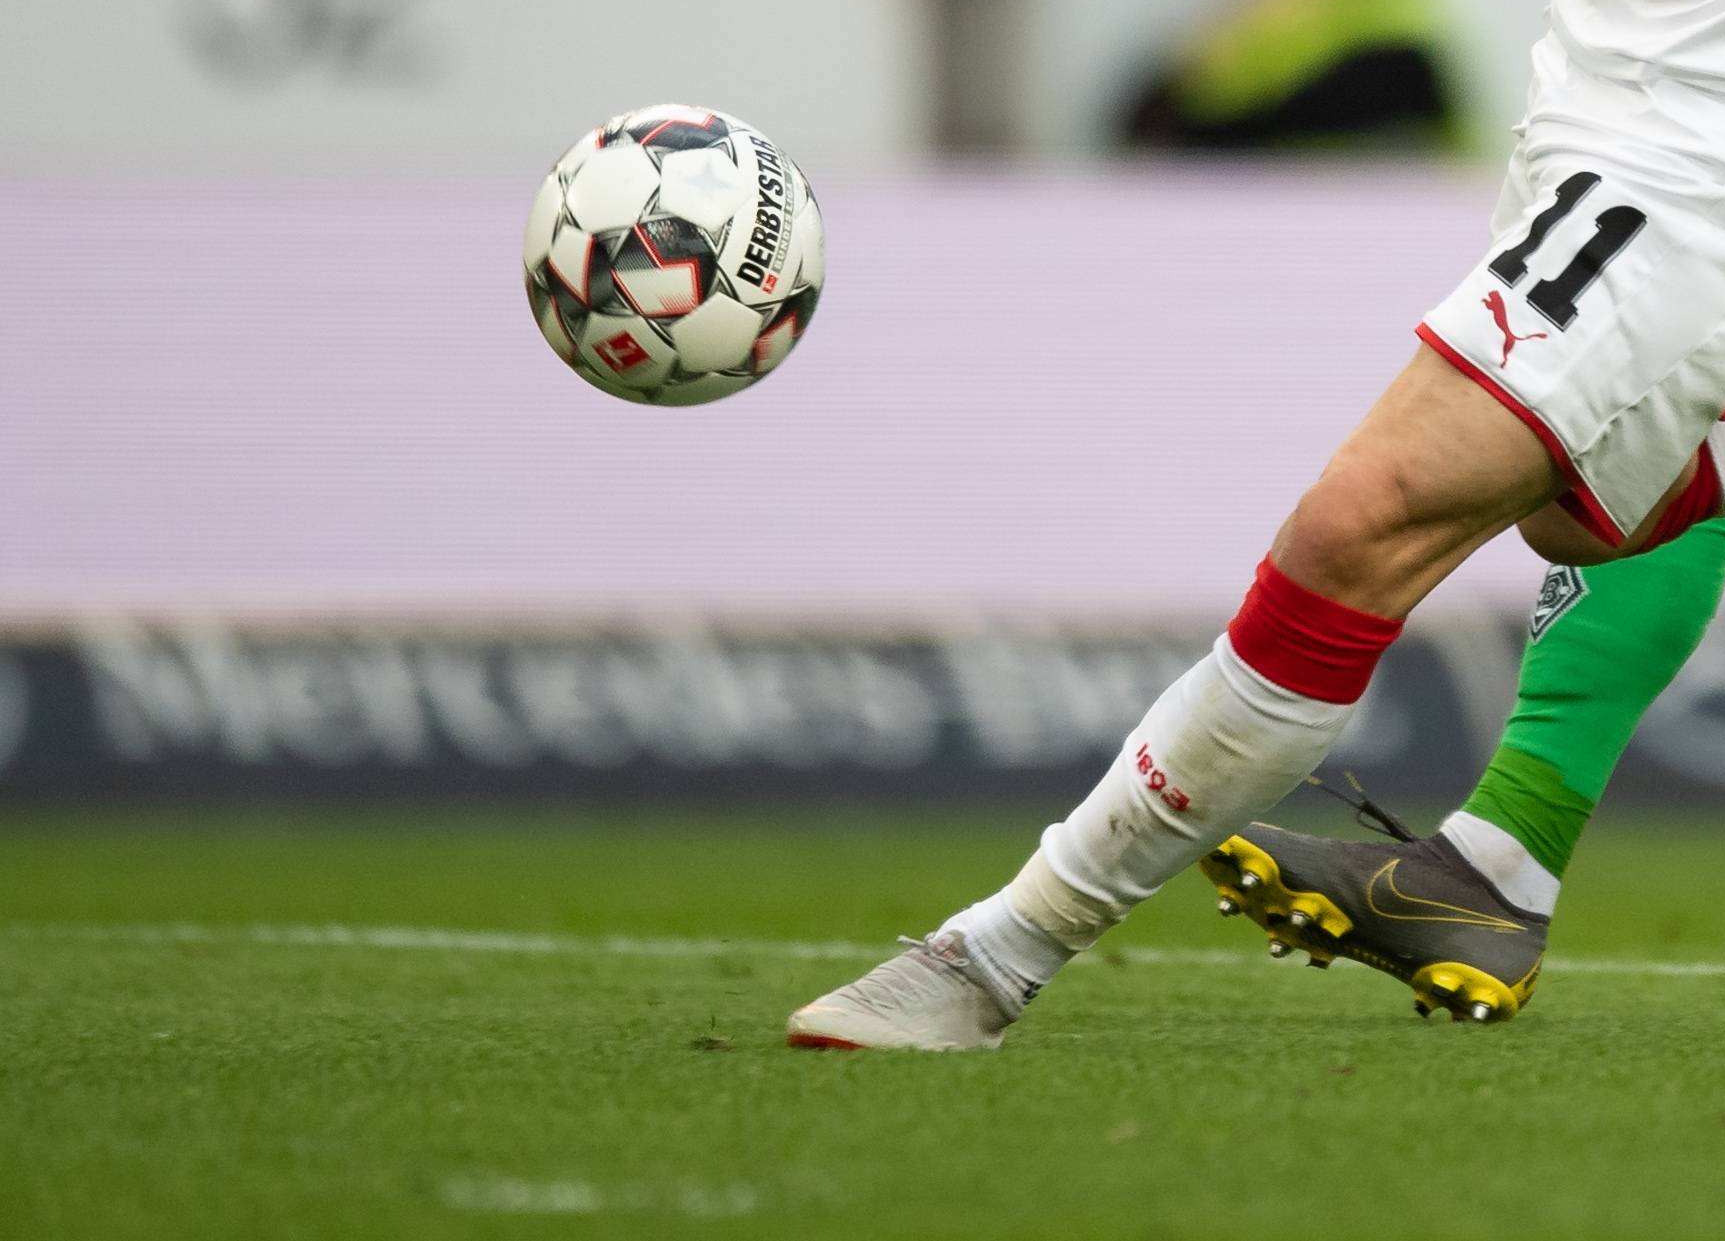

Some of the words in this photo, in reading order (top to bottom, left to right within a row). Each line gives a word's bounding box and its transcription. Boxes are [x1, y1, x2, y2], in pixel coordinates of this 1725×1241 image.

[736, 135, 784, 288] DERBYSTAR
[1488, 171, 1647, 332] 11
[1136, 742, 1190, 812] 1893
